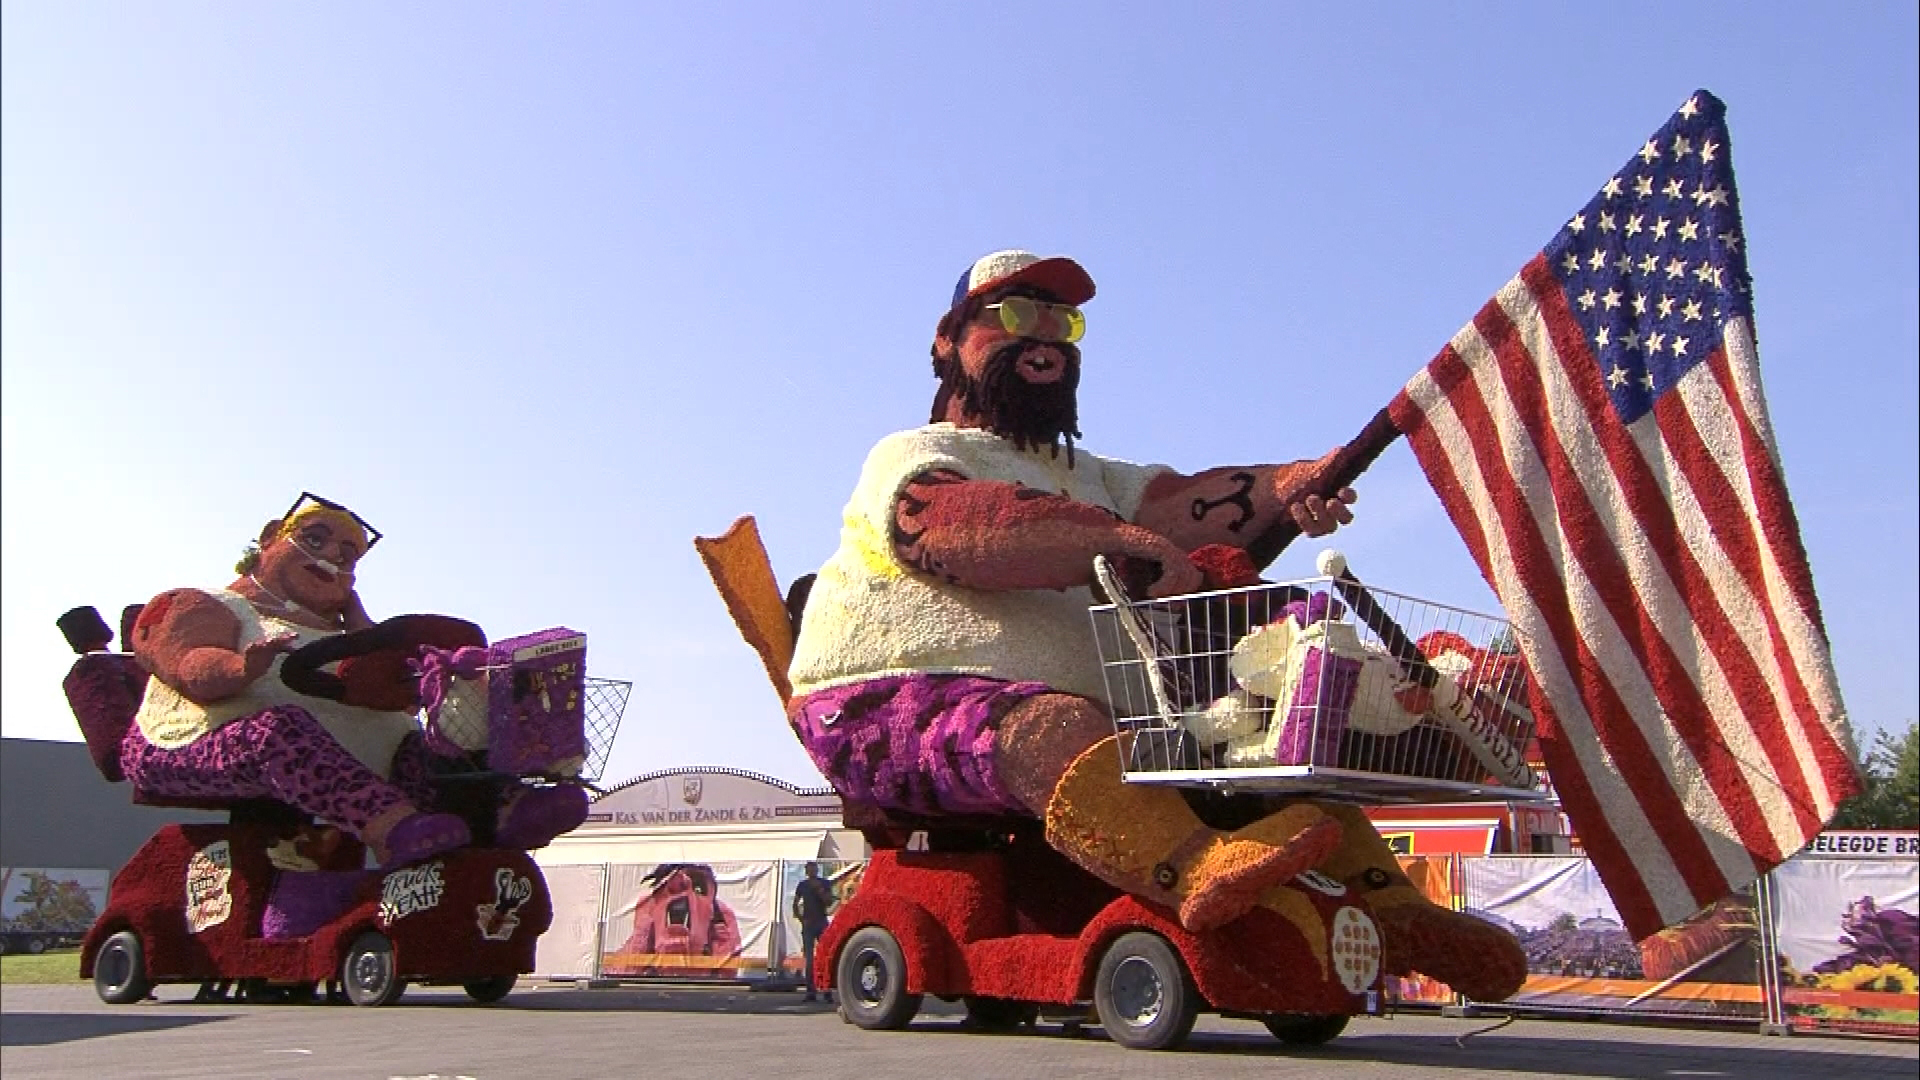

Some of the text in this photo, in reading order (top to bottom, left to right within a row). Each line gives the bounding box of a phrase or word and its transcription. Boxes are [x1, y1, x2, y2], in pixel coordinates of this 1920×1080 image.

[642, 811, 666, 823] VAN
[668, 811, 691, 823] DER
[695, 807, 735, 822] ZANDE
[739, 807, 749, 821] &
